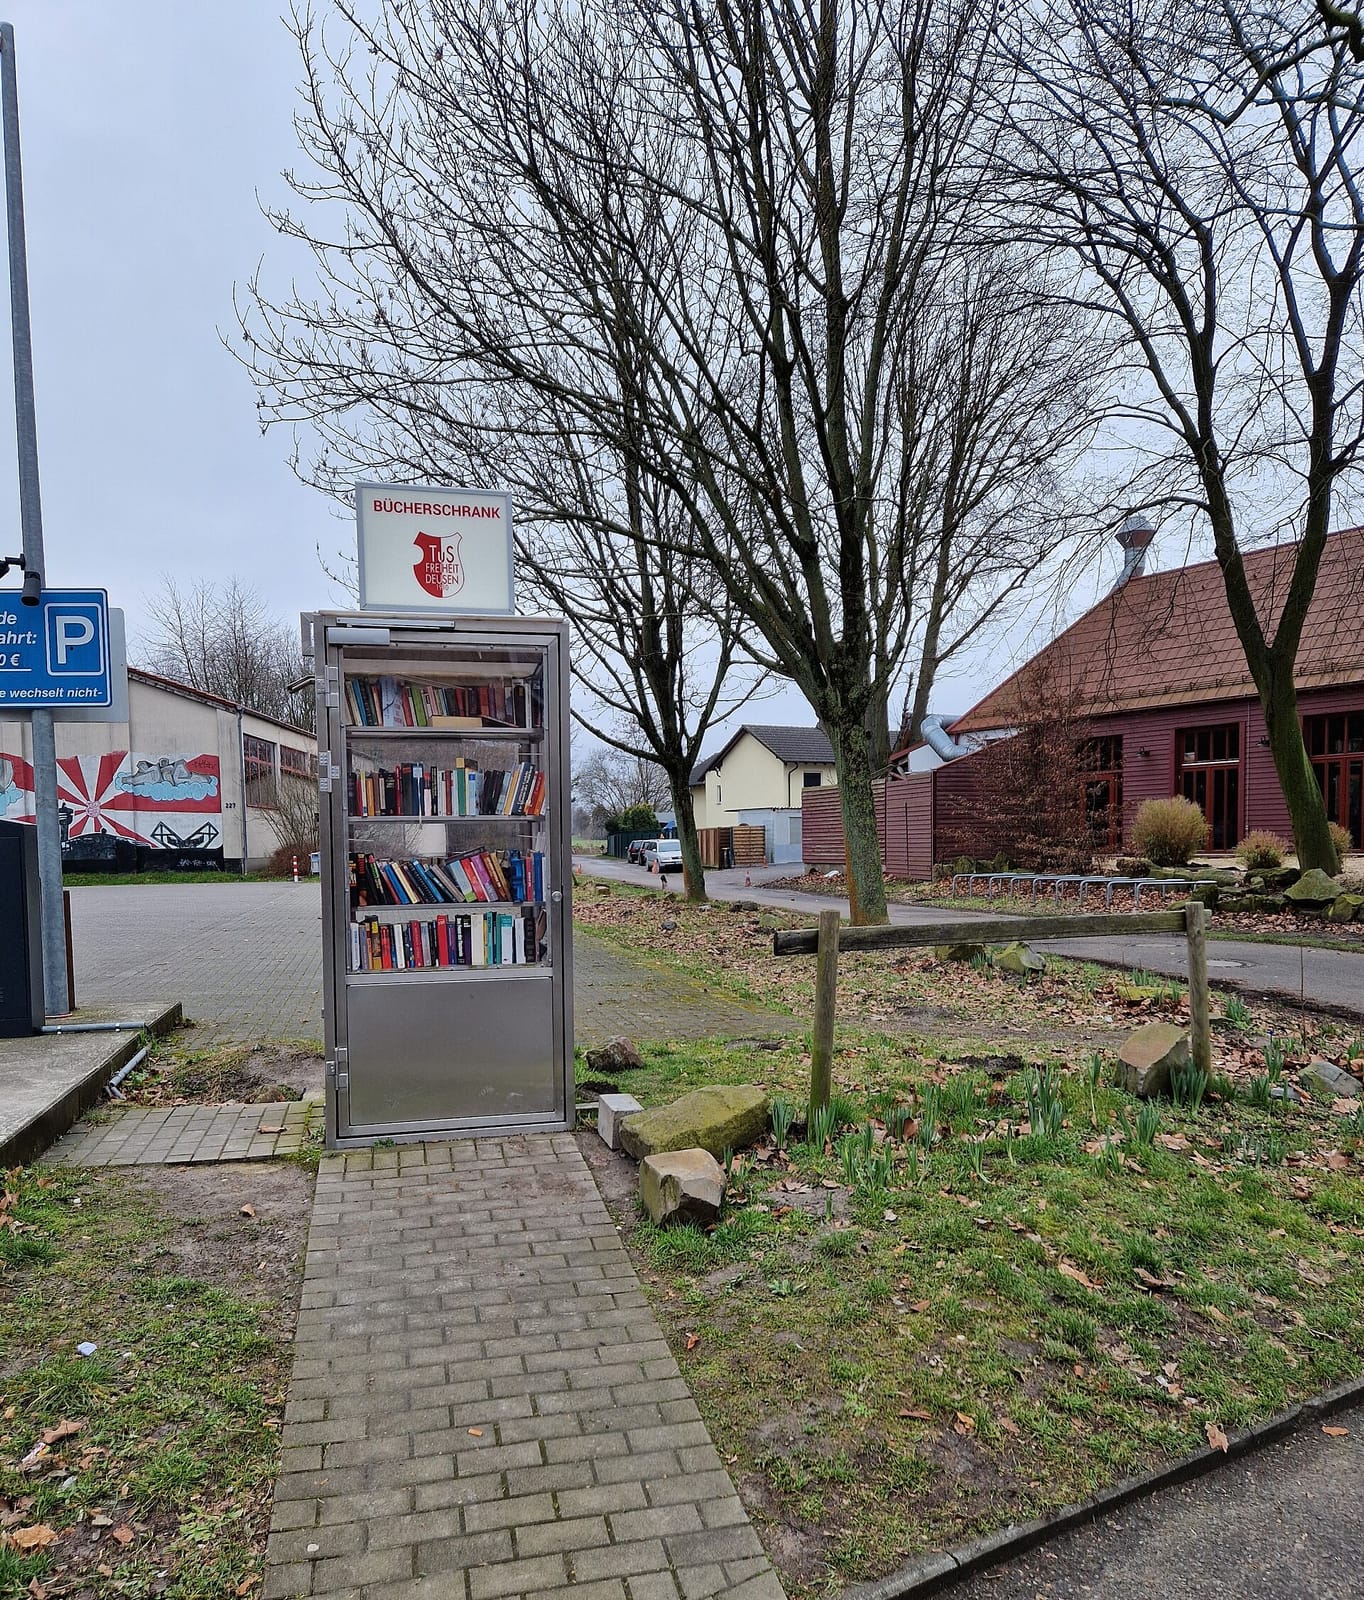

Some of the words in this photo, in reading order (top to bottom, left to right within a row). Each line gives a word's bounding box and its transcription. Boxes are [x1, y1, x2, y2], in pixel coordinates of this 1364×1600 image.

[373, 498, 501, 519] BÜCHERSCHRANK
[428, 544, 455, 563] TuS
[425, 562, 459, 574] FREIHEIT
[425, 573, 459, 585] DEUSEN
[56, 616, 94, 664] P
[10, 653, 21, 666] €
[10, 687, 64, 699] wechselt
[67, 687, 103, 698] nicht-
